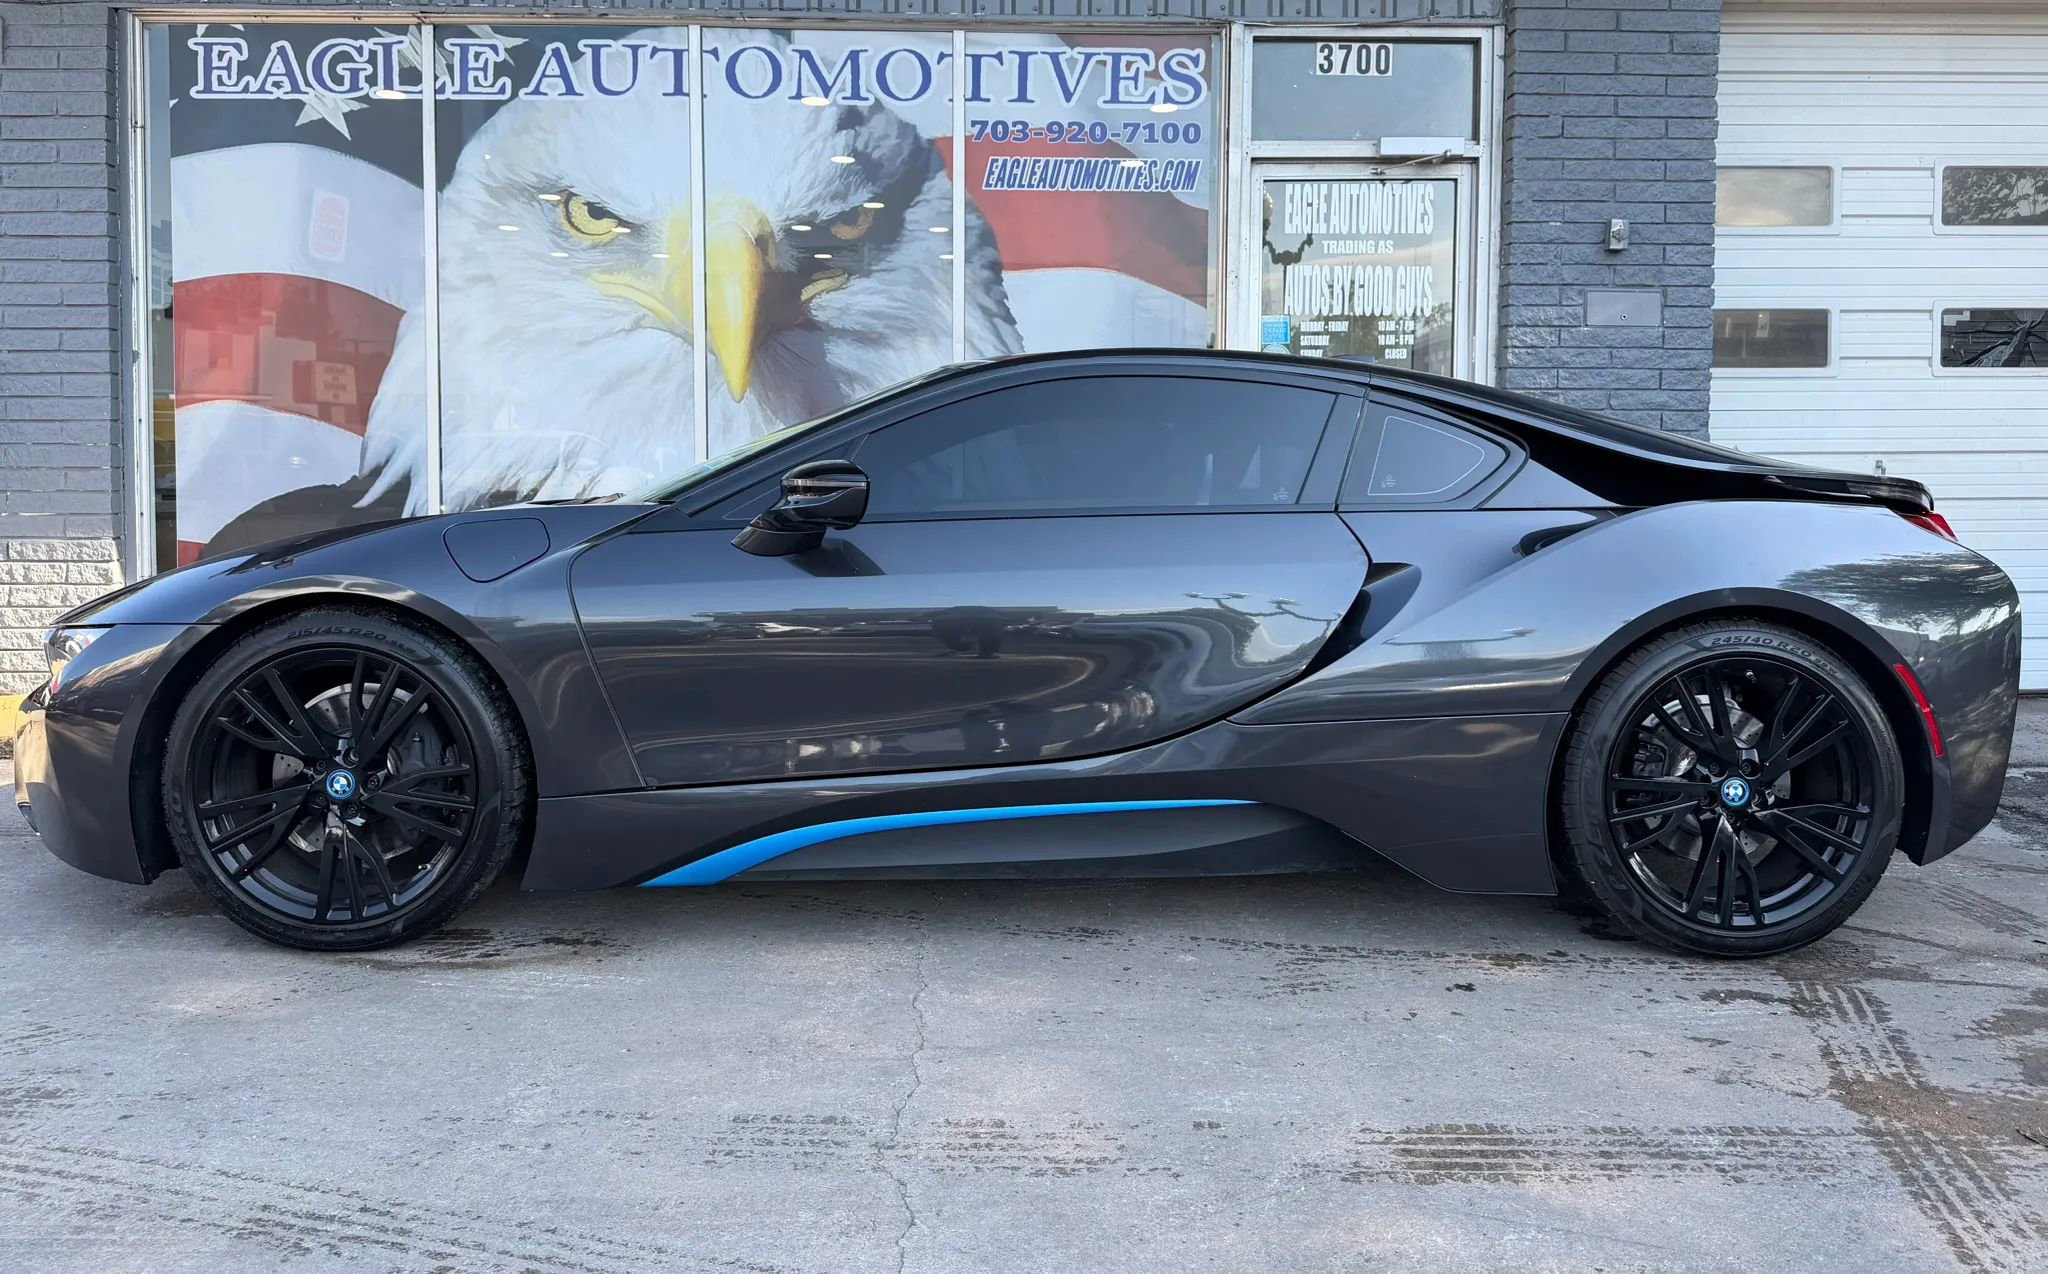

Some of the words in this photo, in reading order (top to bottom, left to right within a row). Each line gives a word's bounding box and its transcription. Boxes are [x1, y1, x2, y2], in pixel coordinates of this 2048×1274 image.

[1319, 43, 1391, 75] 3700
[189, 38, 511, 99] EAGLE
[519, 40, 1207, 108] AUTOMOTIVES
[970, 120, 1202, 145] 703-920-7100
[982, 156, 1203, 192] EAGLEAUTOMOTIVES.COM
[1284, 183, 1328, 235] EAGLE
[1330, 183, 1434, 235] AUTOMOTIVES
[1322, 240, 1375, 254] TRADING
[1377, 240, 1394, 254] AS
[1354, 265, 1393, 317] GOOD
[1395, 265, 1433, 317] GUYS
[1328, 321, 1349, 331] FRIDAY
[1300, 335, 1330, 346] SATURDAY
[1385, 348, 1408, 360] CLOSED
[1711, 635, 1774, 646] 245/40
